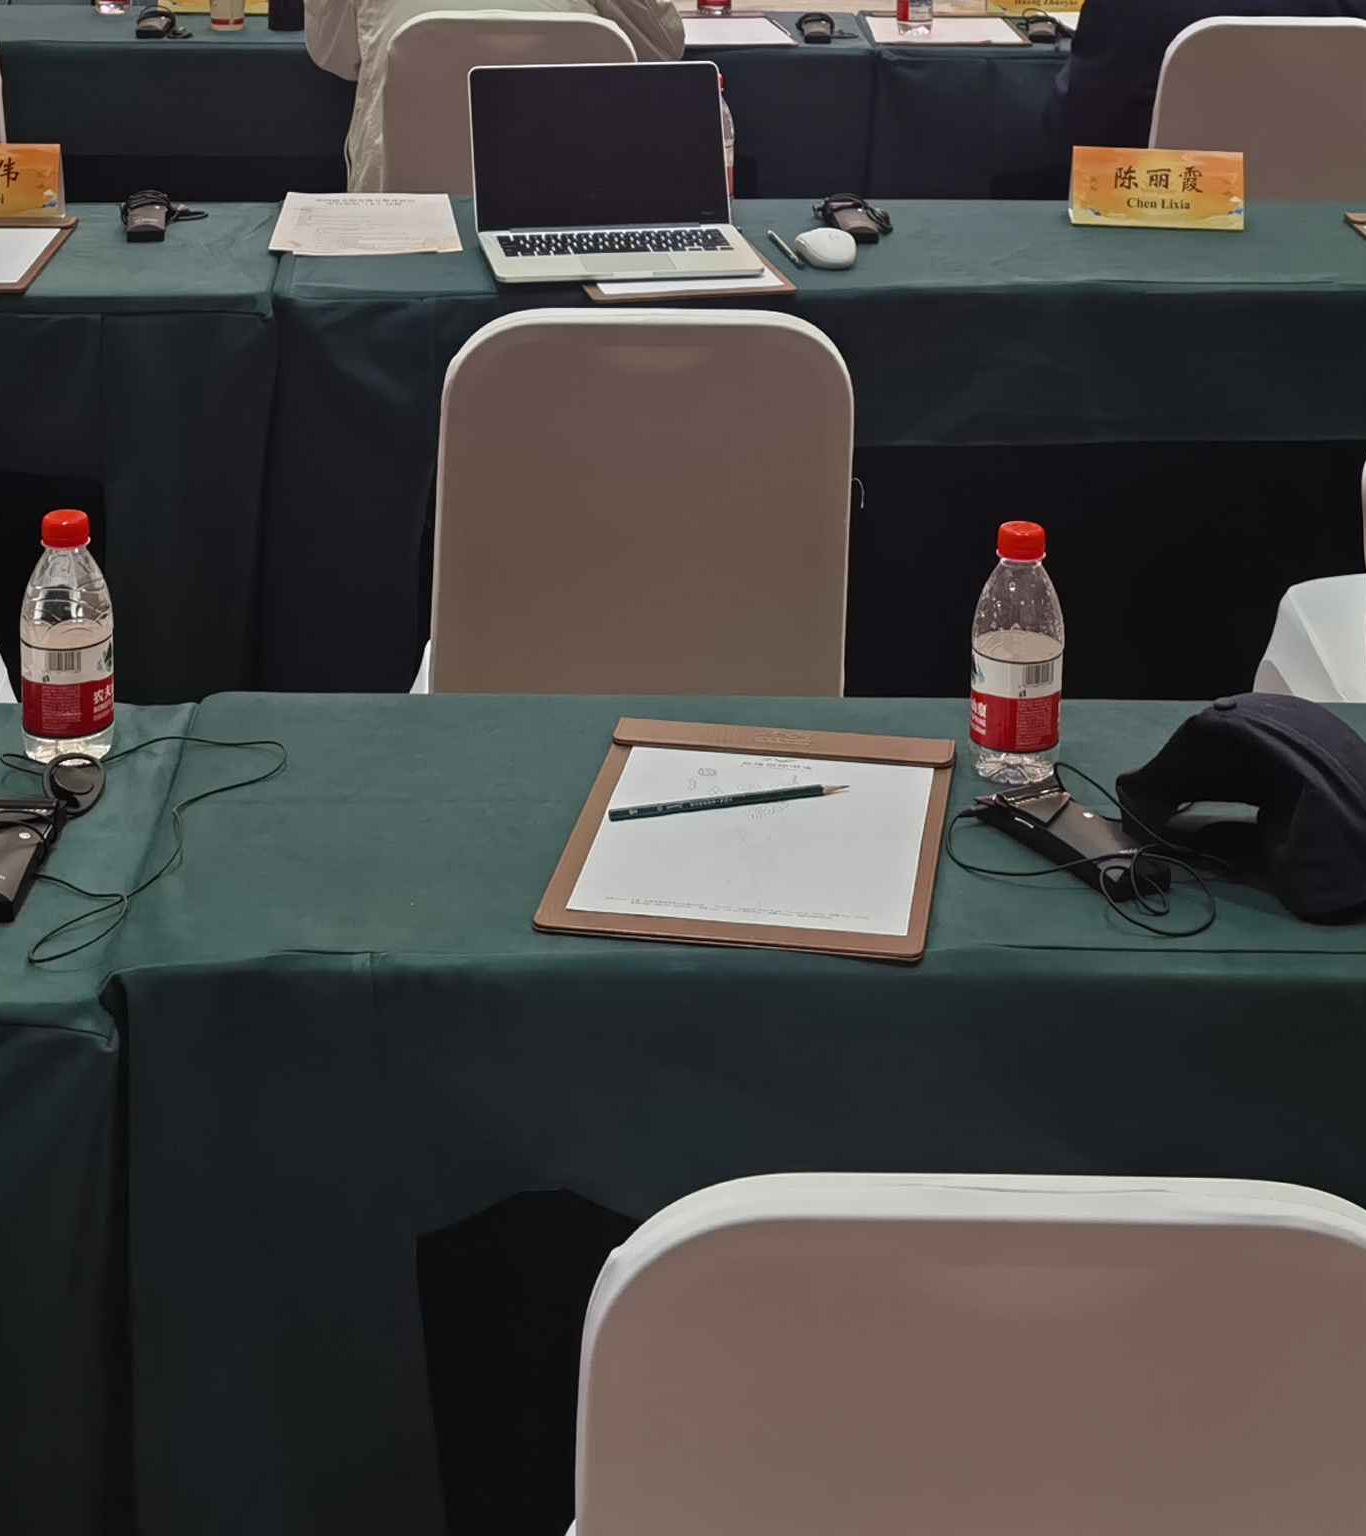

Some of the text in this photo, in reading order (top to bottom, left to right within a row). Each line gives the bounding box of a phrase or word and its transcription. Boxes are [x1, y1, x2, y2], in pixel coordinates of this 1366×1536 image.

[1114, 165, 1204, 193] 陈丽霞
[1126, 197, 1191, 210] Chen Lixia
